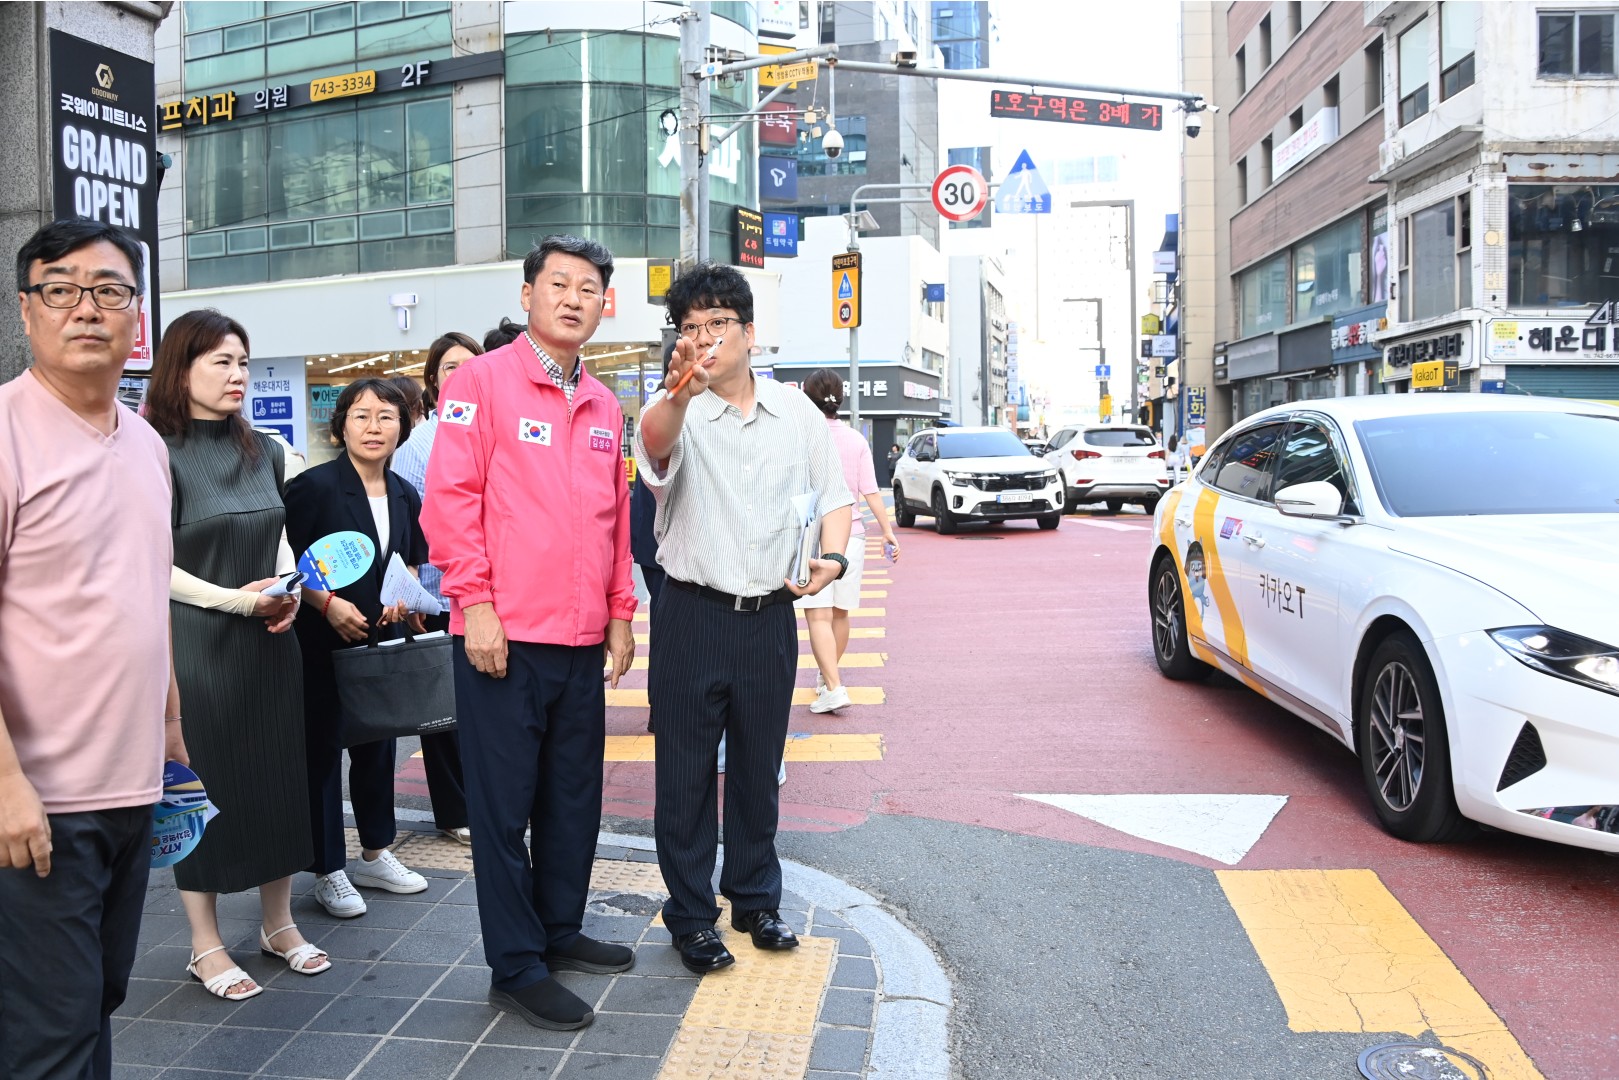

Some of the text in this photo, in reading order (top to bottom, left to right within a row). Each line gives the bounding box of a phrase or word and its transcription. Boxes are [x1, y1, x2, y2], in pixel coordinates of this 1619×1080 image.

[400, 60, 430, 88] 2F
[91, 86, 118, 102] GOODWAY
[312, 76, 372, 97] 743-3334
[61, 92, 147, 132] 굿웨이 피트니스
[162, 84, 288, 131] 프치과 의원
[1099, 102, 1130, 124] 3배
[62, 124, 147, 184] GRAND
[75, 176, 140, 229] OPEN
[944, 182, 974, 206] 30
[766, 237, 794, 248] 드림약국
[841, 308, 850, 319] 30
[1414, 368, 1438, 382] kakaoT
[253, 380, 290, 392] 해운대지점
[322, 388, 339, 402] 어르
[1188, 386, 1206, 418] 만화
[592, 438, 610, 450] 김성수
[1260, 574, 1306, 619] 카카오T
[162, 830, 192, 843] 정차역은
[156, 842, 182, 858] KTX
